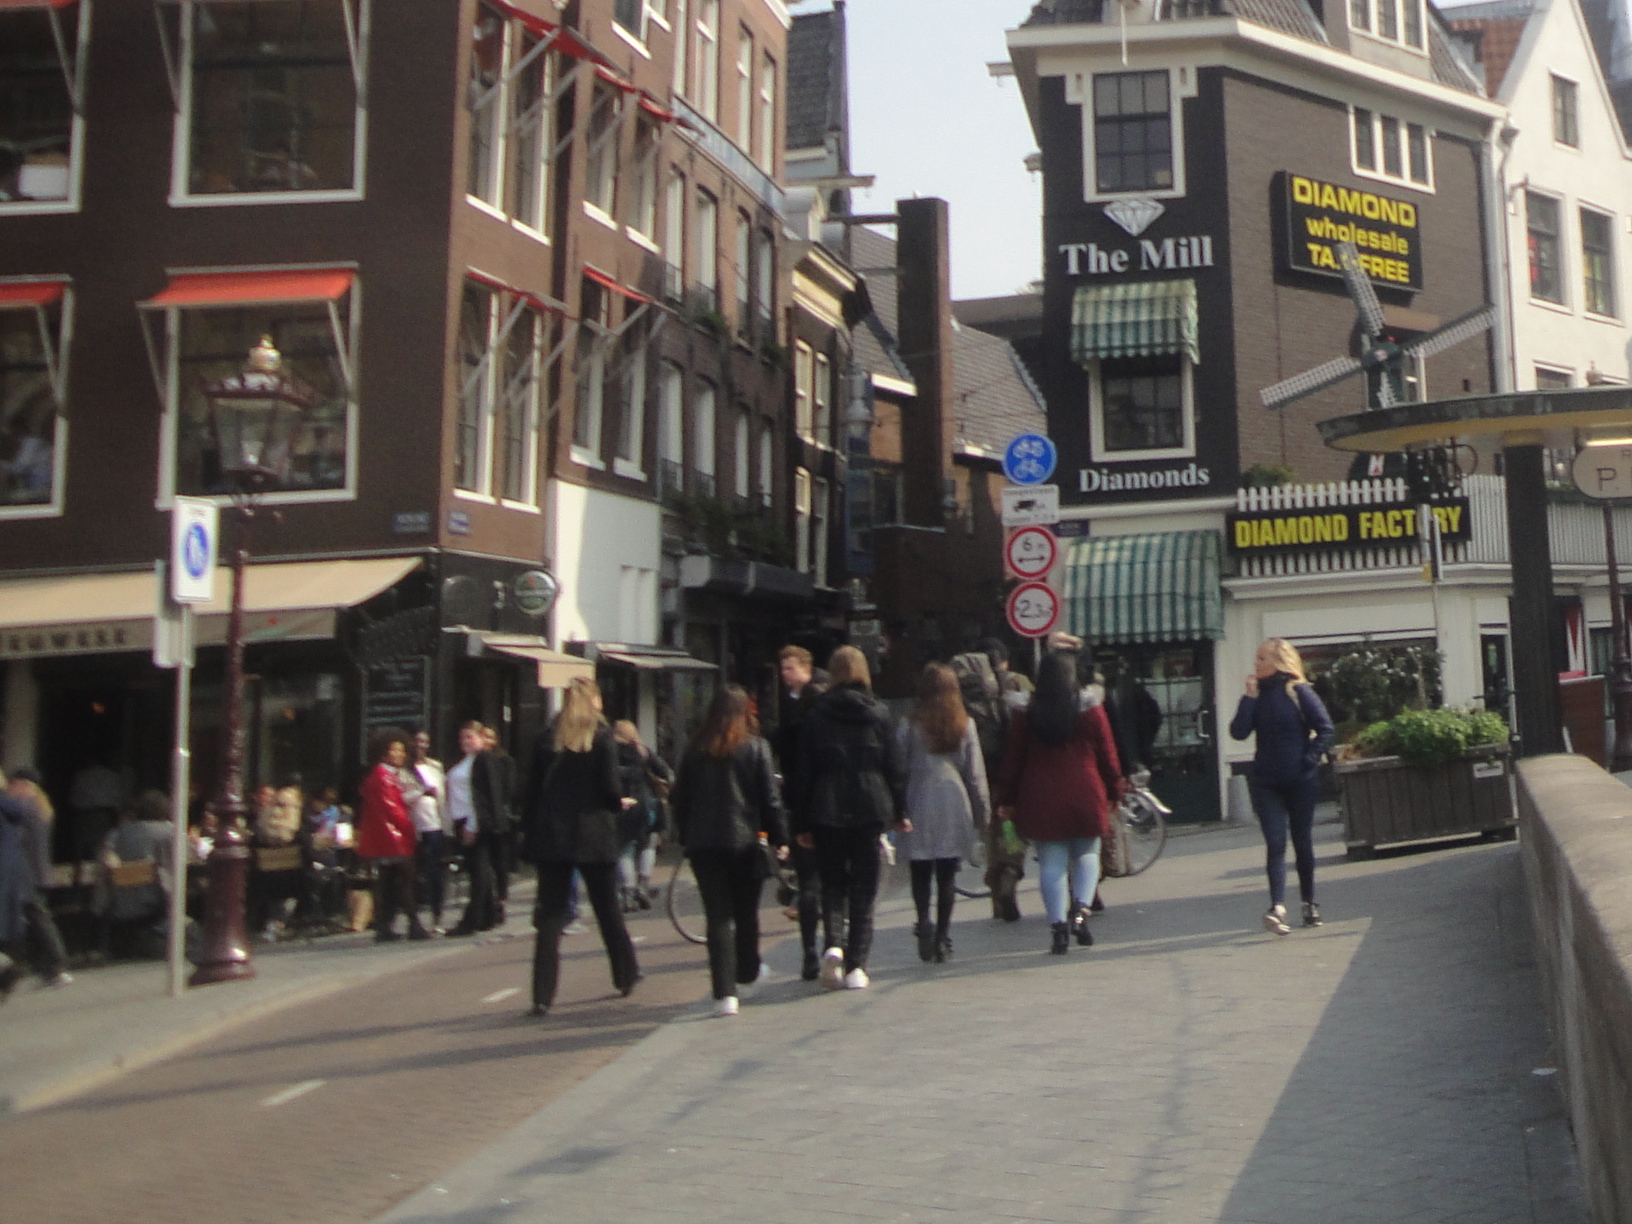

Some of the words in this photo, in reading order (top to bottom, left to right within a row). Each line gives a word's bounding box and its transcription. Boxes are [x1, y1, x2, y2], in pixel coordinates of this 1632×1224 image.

[1292, 176, 1417, 228] DIAMOND
[1058, 243, 1129, 275] The
[1138, 235, 1214, 271] Mill
[1305, 216, 1409, 255] wholesale
[1079, 463, 1211, 493] Diamonds
[1234, 513, 1348, 548] DIAMOND
[1358, 505, 1462, 540] FACTRY
